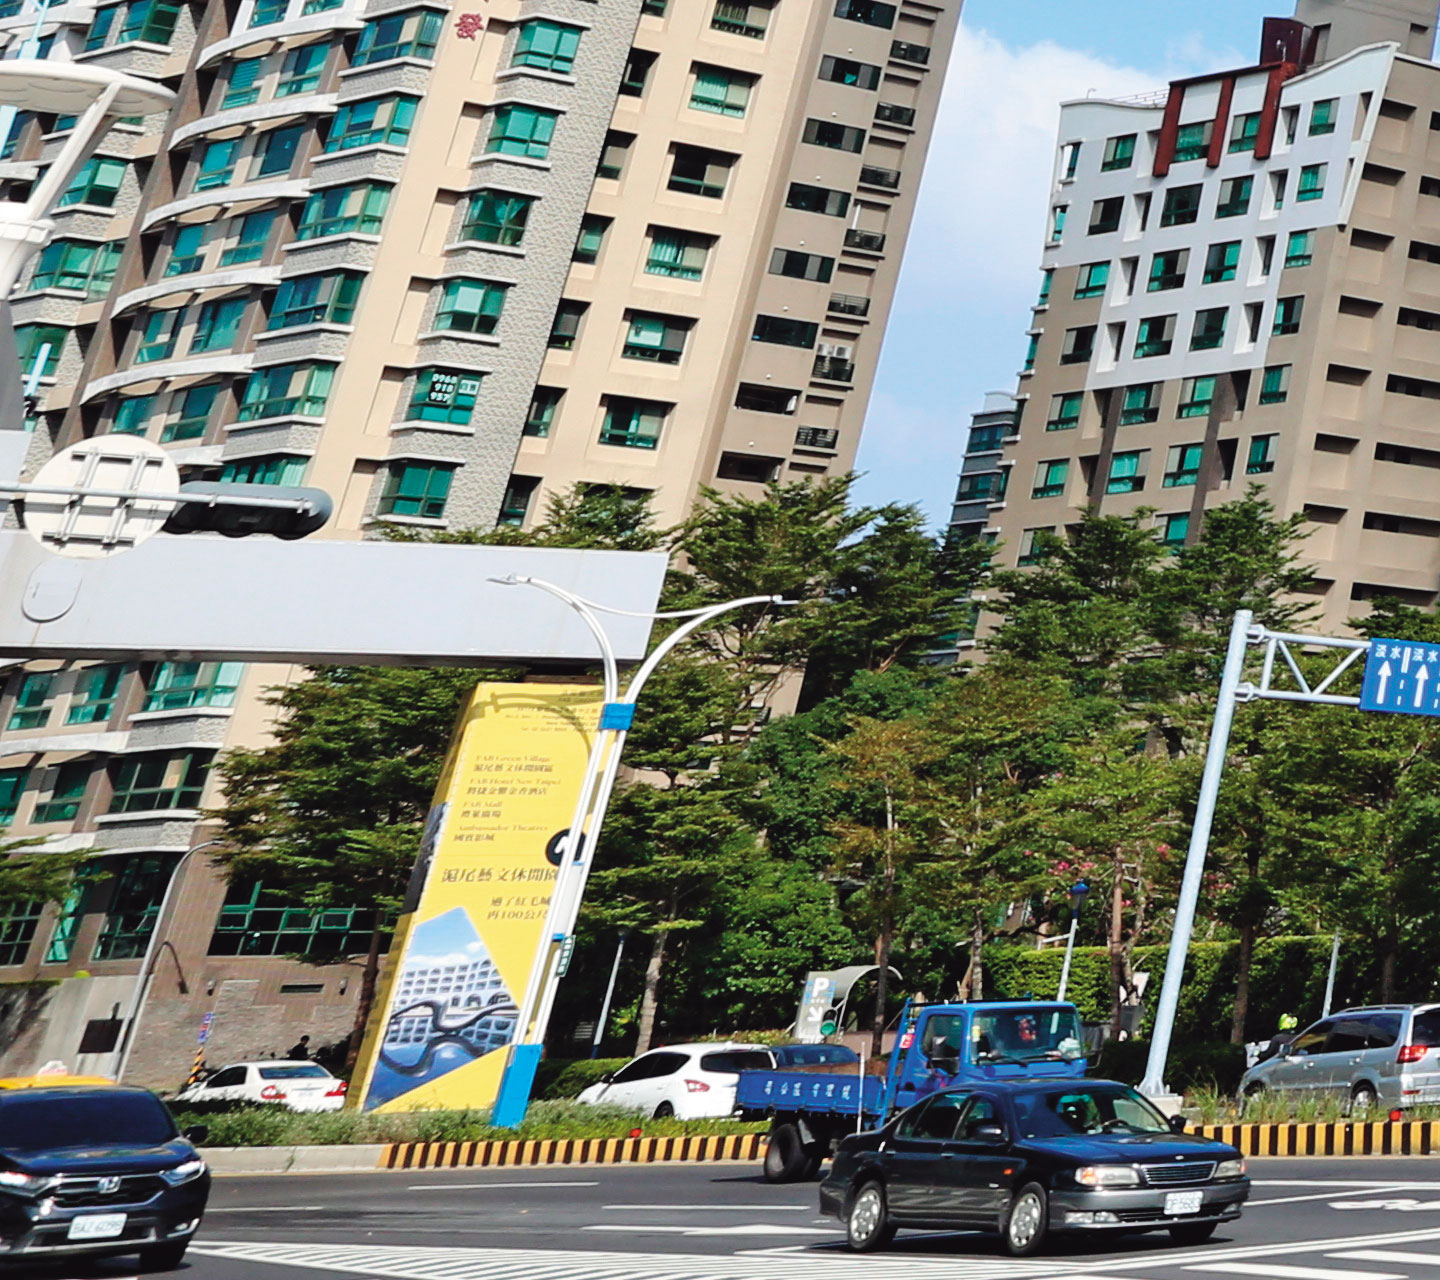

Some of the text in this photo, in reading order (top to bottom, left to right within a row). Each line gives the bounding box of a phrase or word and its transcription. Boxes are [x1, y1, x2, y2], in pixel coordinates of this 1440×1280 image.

[1375, 644, 1401, 660] 淡水
[1412, 648, 1438, 663] 淡水
[813, 978, 829, 998] P
